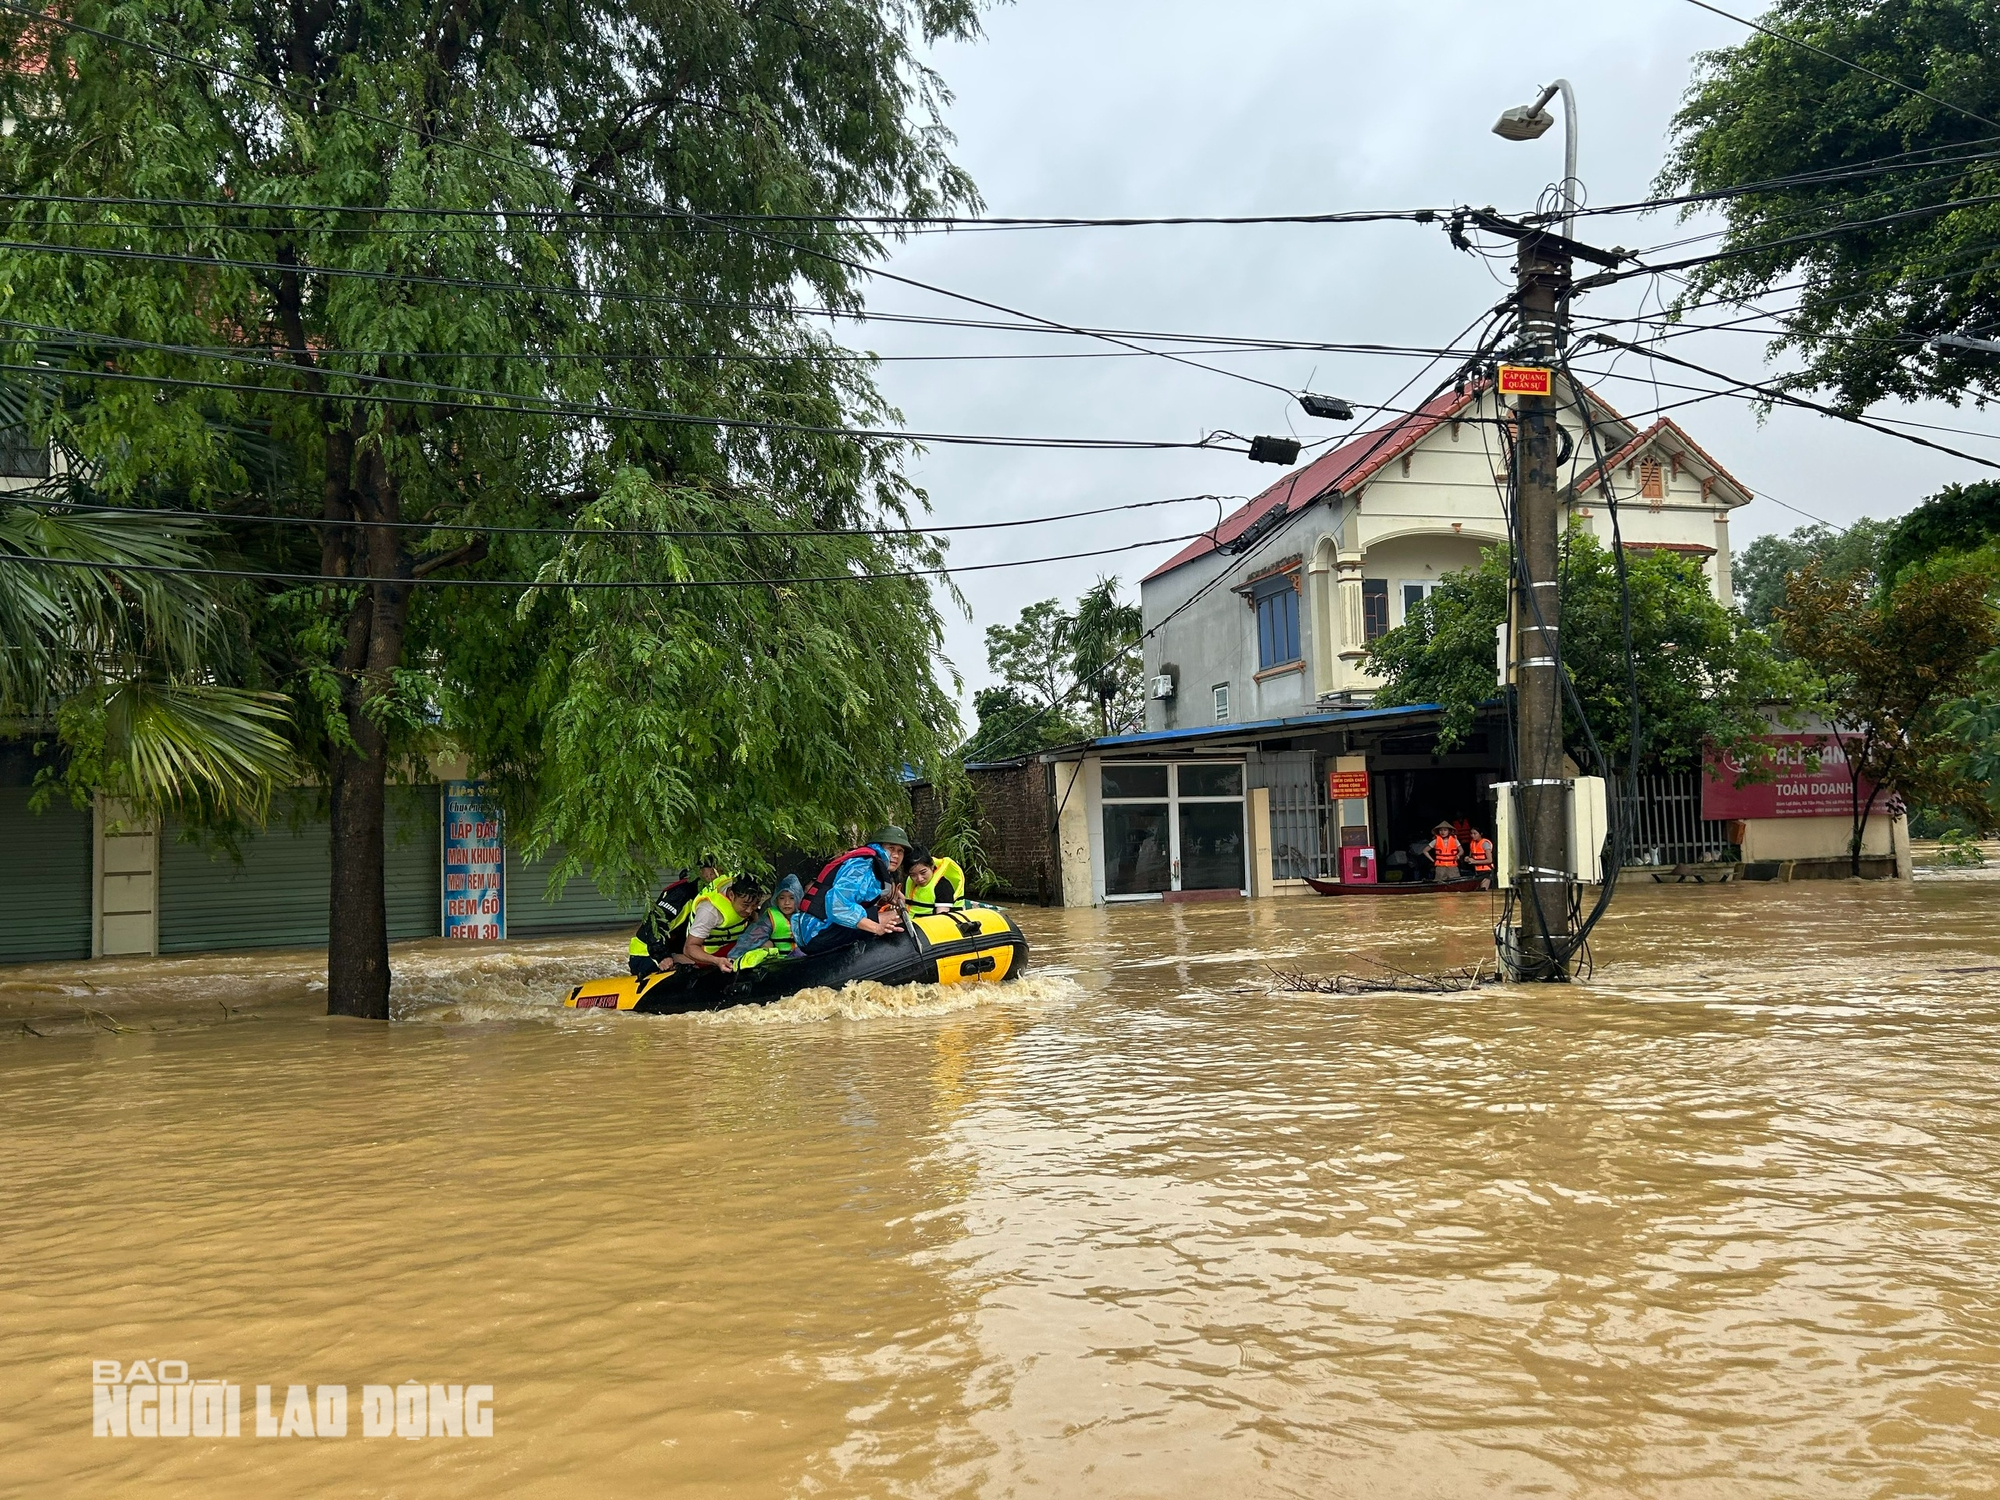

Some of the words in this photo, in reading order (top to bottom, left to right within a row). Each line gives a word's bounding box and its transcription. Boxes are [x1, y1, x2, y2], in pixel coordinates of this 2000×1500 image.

[1519, 373, 1546, 383] QUANG
[1811, 782, 1853, 795] DOANH
[451, 818, 473, 839] LẮP
[471, 847, 501, 865] KHUNG
[467, 870, 485, 890] RÈM
[448, 896, 478, 916] RÈM
[481, 891, 500, 915] GỖ
[450, 922, 479, 939] RÈM
[482, 924, 499, 939] 3D
